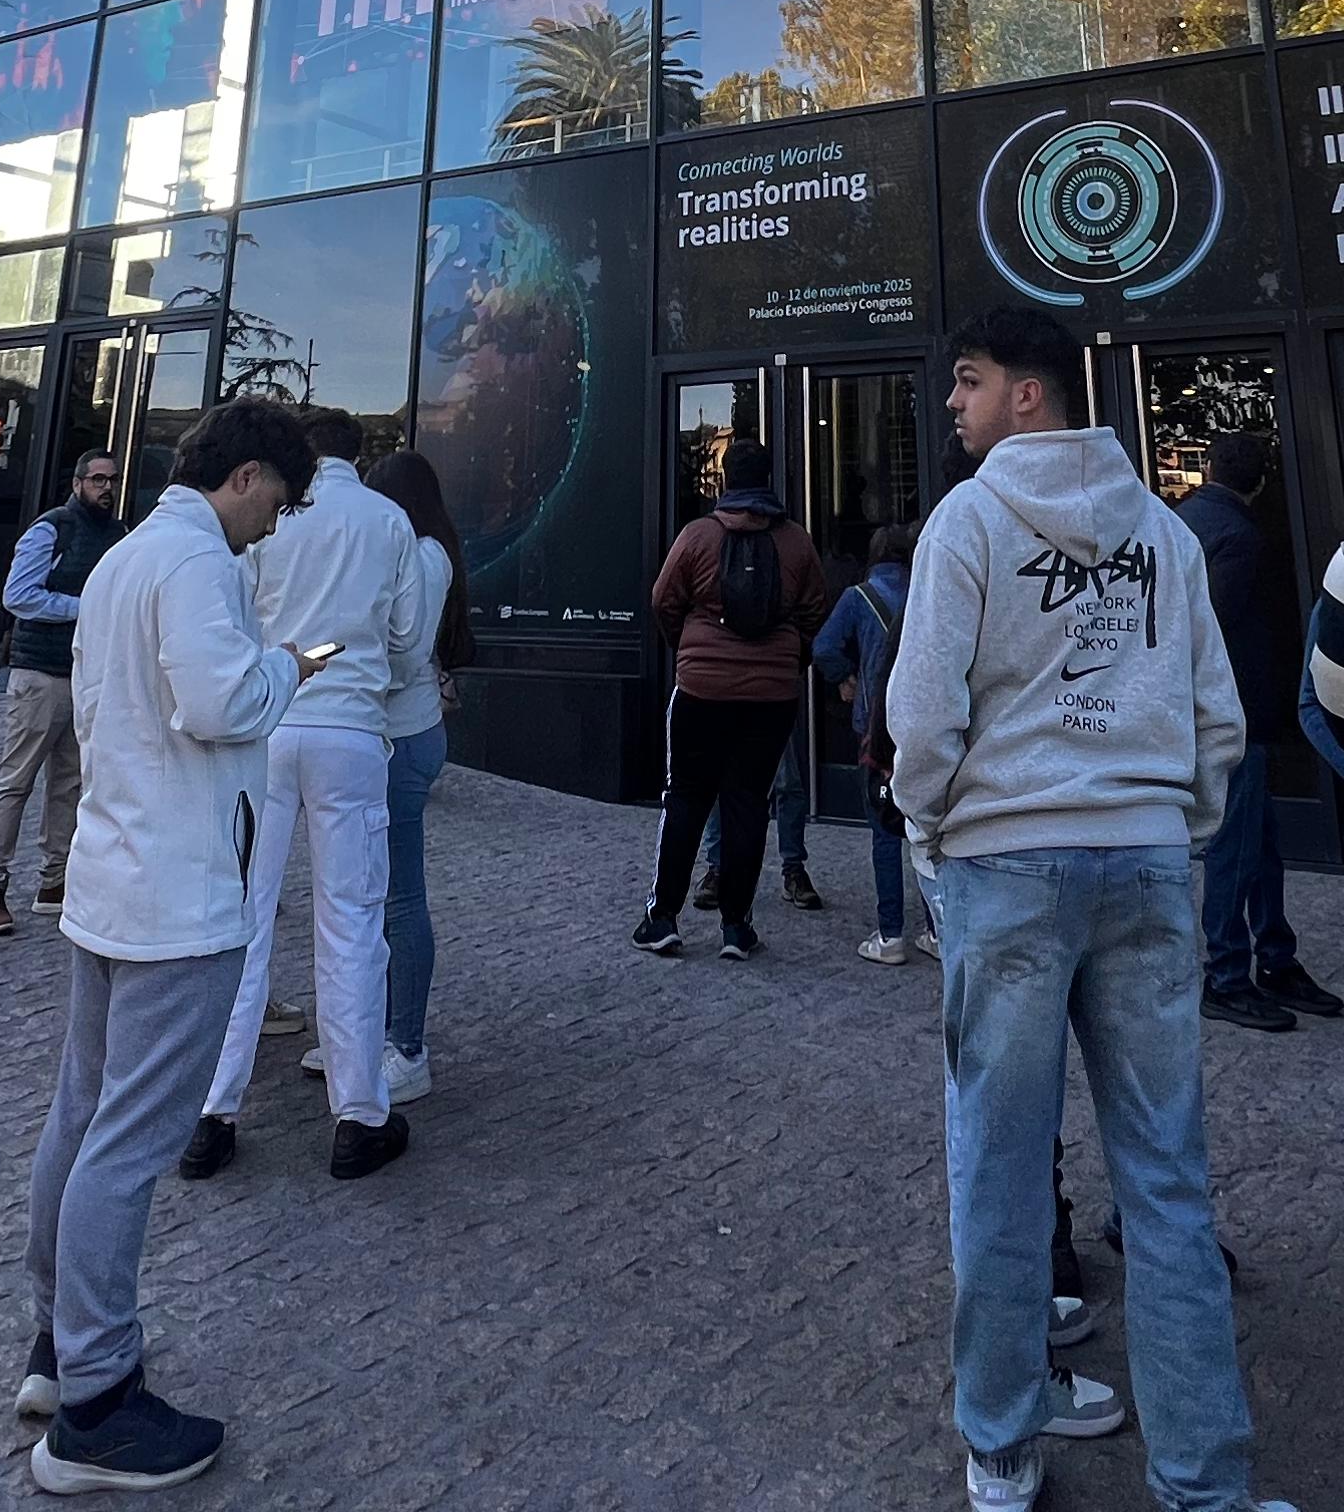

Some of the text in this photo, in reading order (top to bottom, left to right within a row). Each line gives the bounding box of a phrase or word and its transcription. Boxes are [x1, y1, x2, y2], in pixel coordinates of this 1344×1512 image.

[678, 140, 844, 182] Connecting Worlds
[677, 170, 868, 217] Transforming
[678, 213, 791, 249] realities
[766, 290, 780, 304] 10
[788, 288, 801, 301] 12
[803, 286, 818, 300] de
[819, 280, 882, 298] noviembre
[883, 278, 912, 293] 2025
[748, 295, 913, 320] Palacio Exposiciones y Congresos
[868, 310, 914, 324] Granada
[1054, 693, 1116, 713] LONDON
[1062, 714, 1107, 733] PARIS
